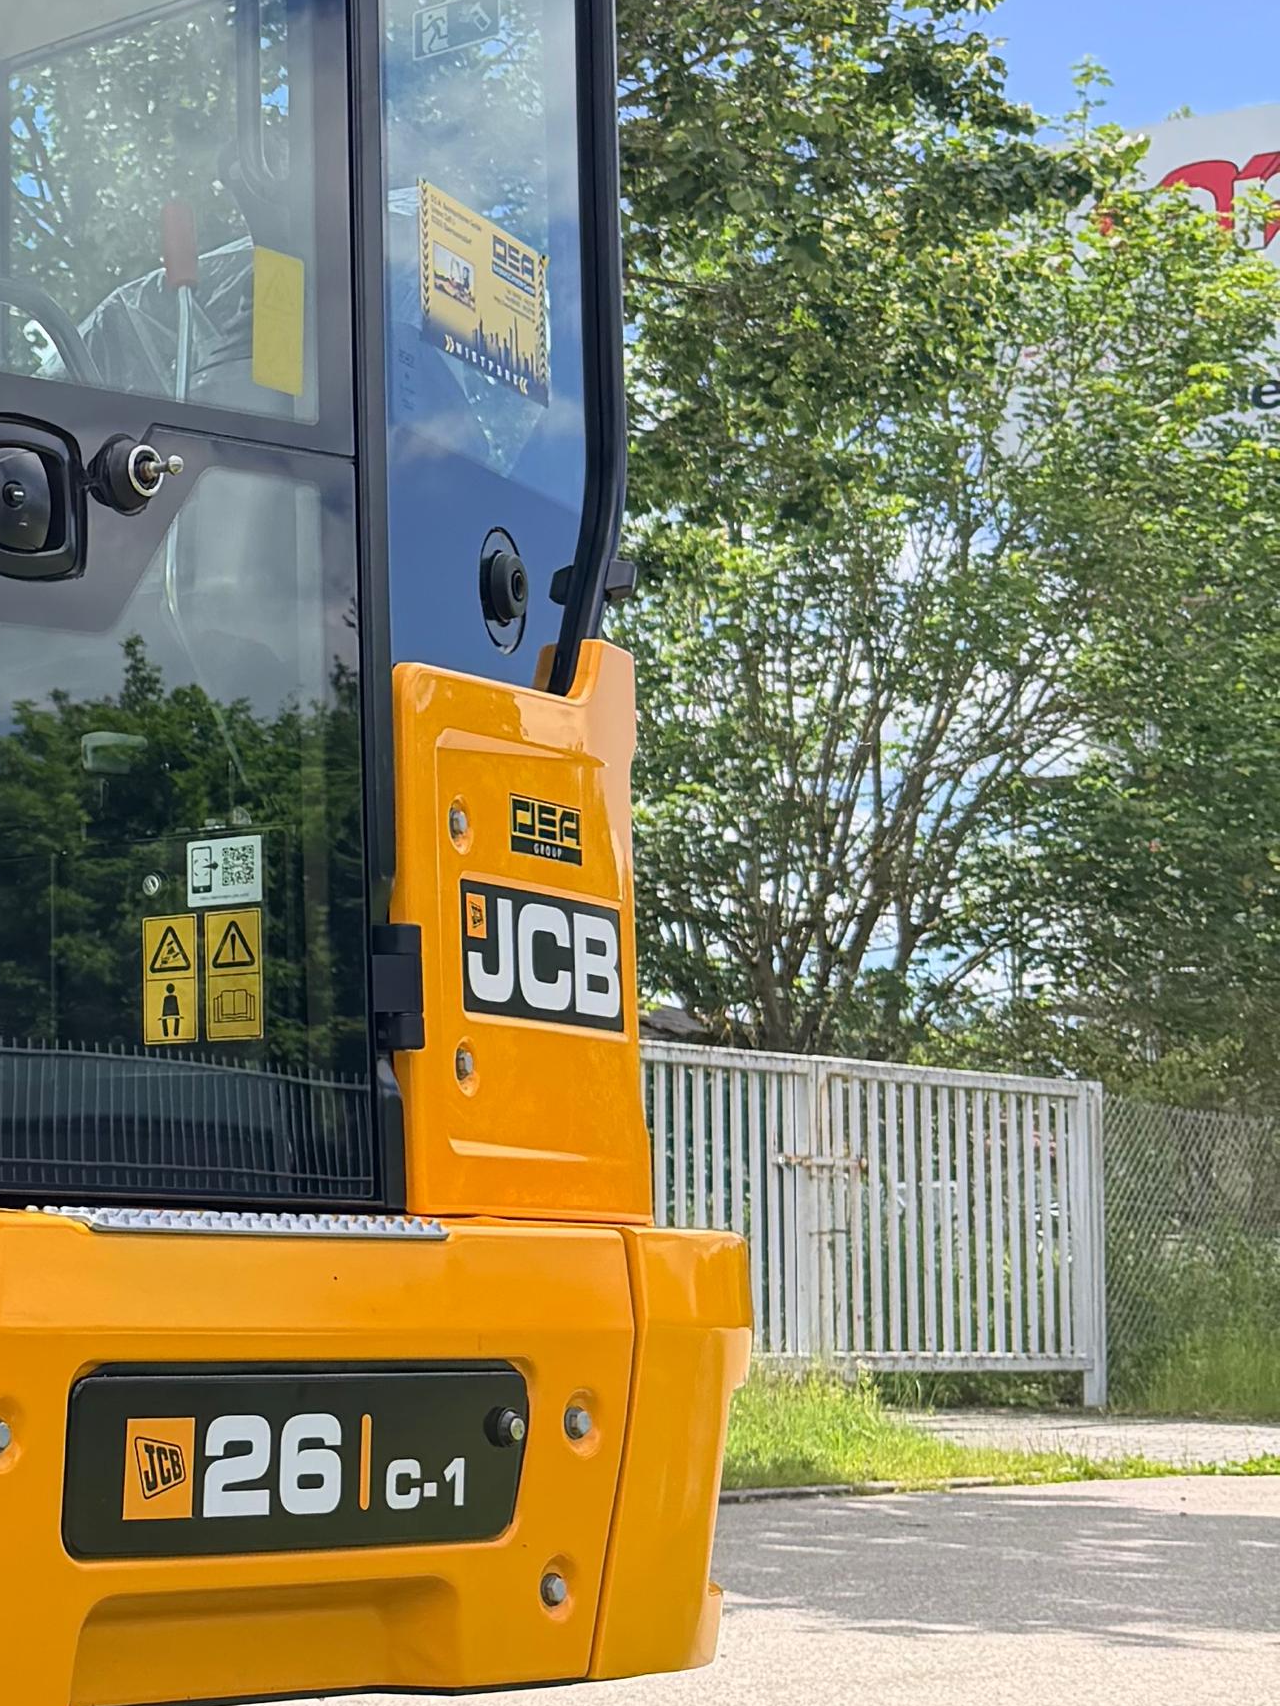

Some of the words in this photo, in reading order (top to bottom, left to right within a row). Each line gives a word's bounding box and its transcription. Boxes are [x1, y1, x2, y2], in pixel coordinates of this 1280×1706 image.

[533, 843, 562, 859] GROUP
[468, 897, 620, 1018] JCB
[143, 1443, 183, 1493] JCB
[203, 1413, 342, 1517] 26
